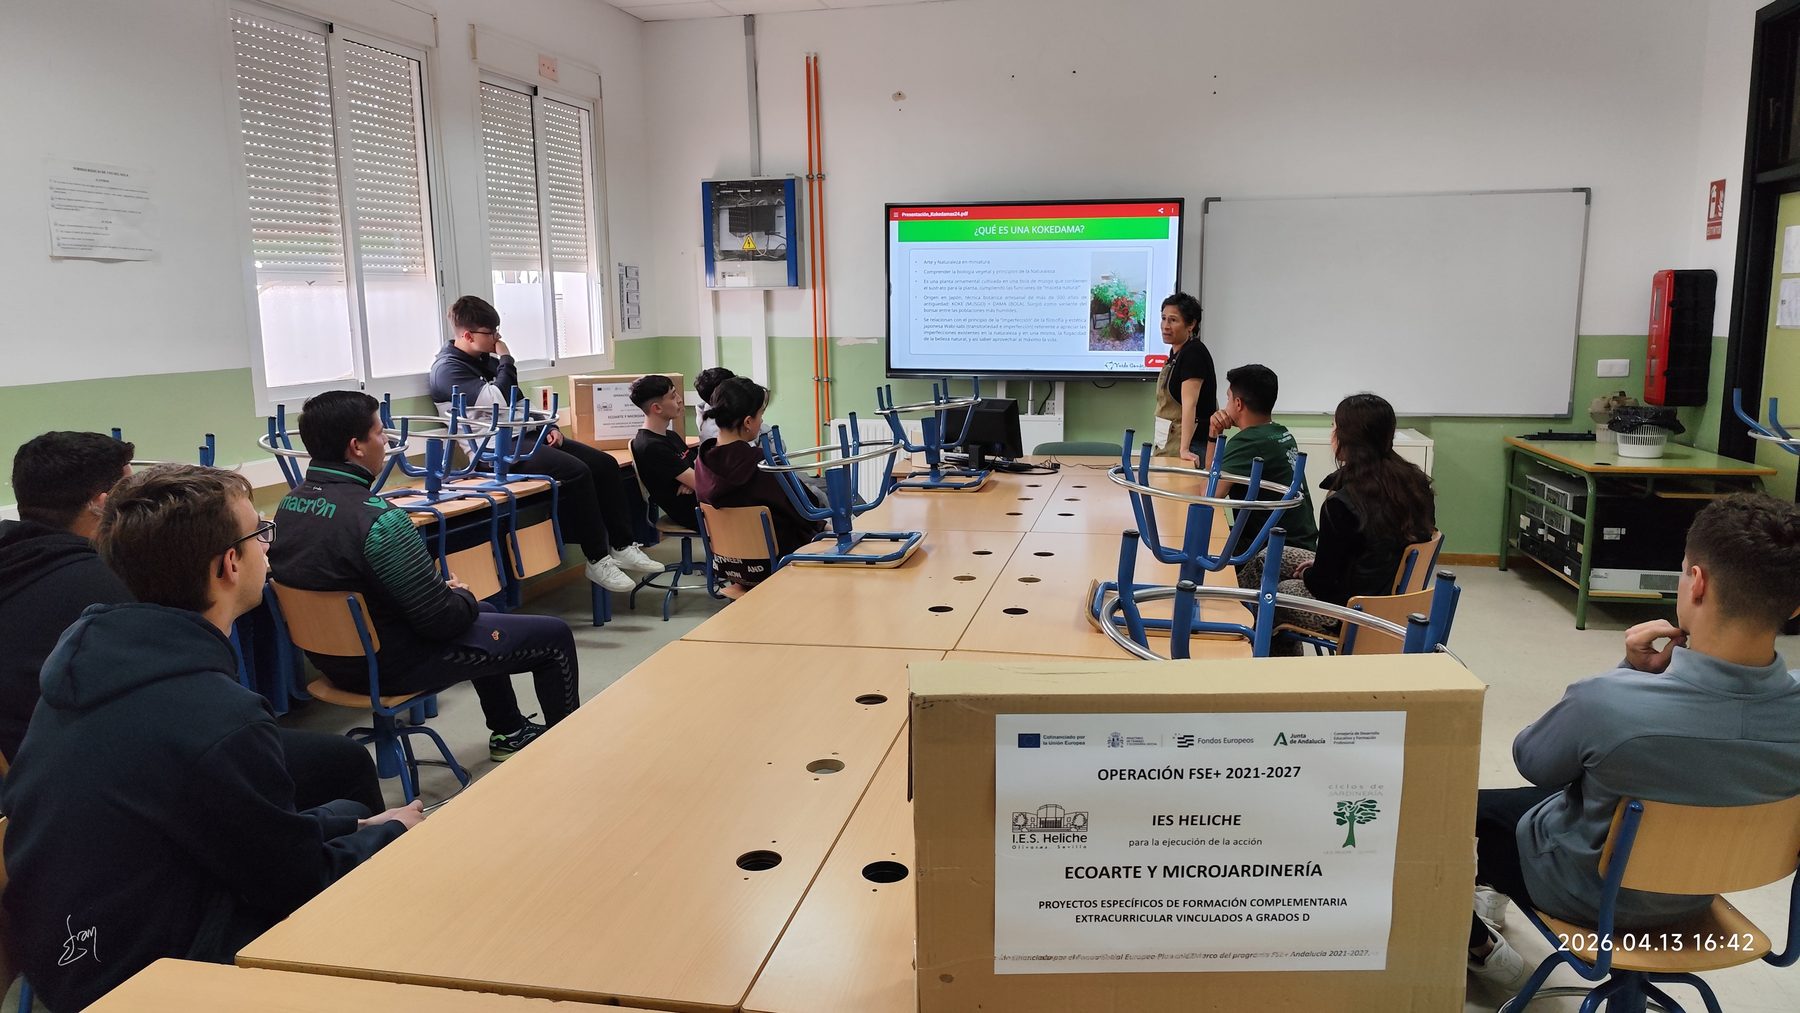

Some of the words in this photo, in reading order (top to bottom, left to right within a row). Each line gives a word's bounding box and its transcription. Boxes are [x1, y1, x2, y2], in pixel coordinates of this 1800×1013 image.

[974, 224, 996, 237] ¿QUÉ
[998, 226, 1009, 235] ES
[1010, 225, 1030, 234] UNA
[1031, 224, 1085, 234] KOKEDAMA?
[1223, 737, 1254, 745] Europeos
[1097, 765, 1184, 780] OPERACIÓN
[1189, 767, 1222, 780] FSE+
[1225, 766, 1301, 779] 2021-2027
[1152, 815, 1174, 826] IES
[1178, 814, 1242, 826] HELICHE
[1012, 834, 1039, 844] I.E.S.
[1043, 833, 1088, 843] Heliche
[1128, 839, 1150, 848] para
[1152, 838, 1160, 846] la
[1162, 838, 1206, 848] ejecución
[1208, 838, 1220, 846] de
[1222, 838, 1231, 846] la
[1233, 837, 1262, 846] acción
[1064, 865, 1142, 879] ECOARTE
[1147, 865, 1158, 879] Y
[1162, 861, 1323, 879] MICROJARDINERÍA
[1038, 900, 1098, 909] PROYECTOS
[1100, 897, 1164, 908] ESPECÍFICOS
[1166, 899, 1180, 908] DE
[1182, 897, 1247, 908] FORMACIÓN
[1250, 897, 1348, 907] COMPLEMENTARIA
[1075, 914, 1173, 923] EXTRACURRICULAR
[1176, 913, 1243, 923] VINCULADOS
[1245, 913, 1253, 922] A
[1256, 913, 1300, 922] GRADOS
[1302, 913, 1310, 921] D
[1289, 950, 1327, 958] Andalucía
